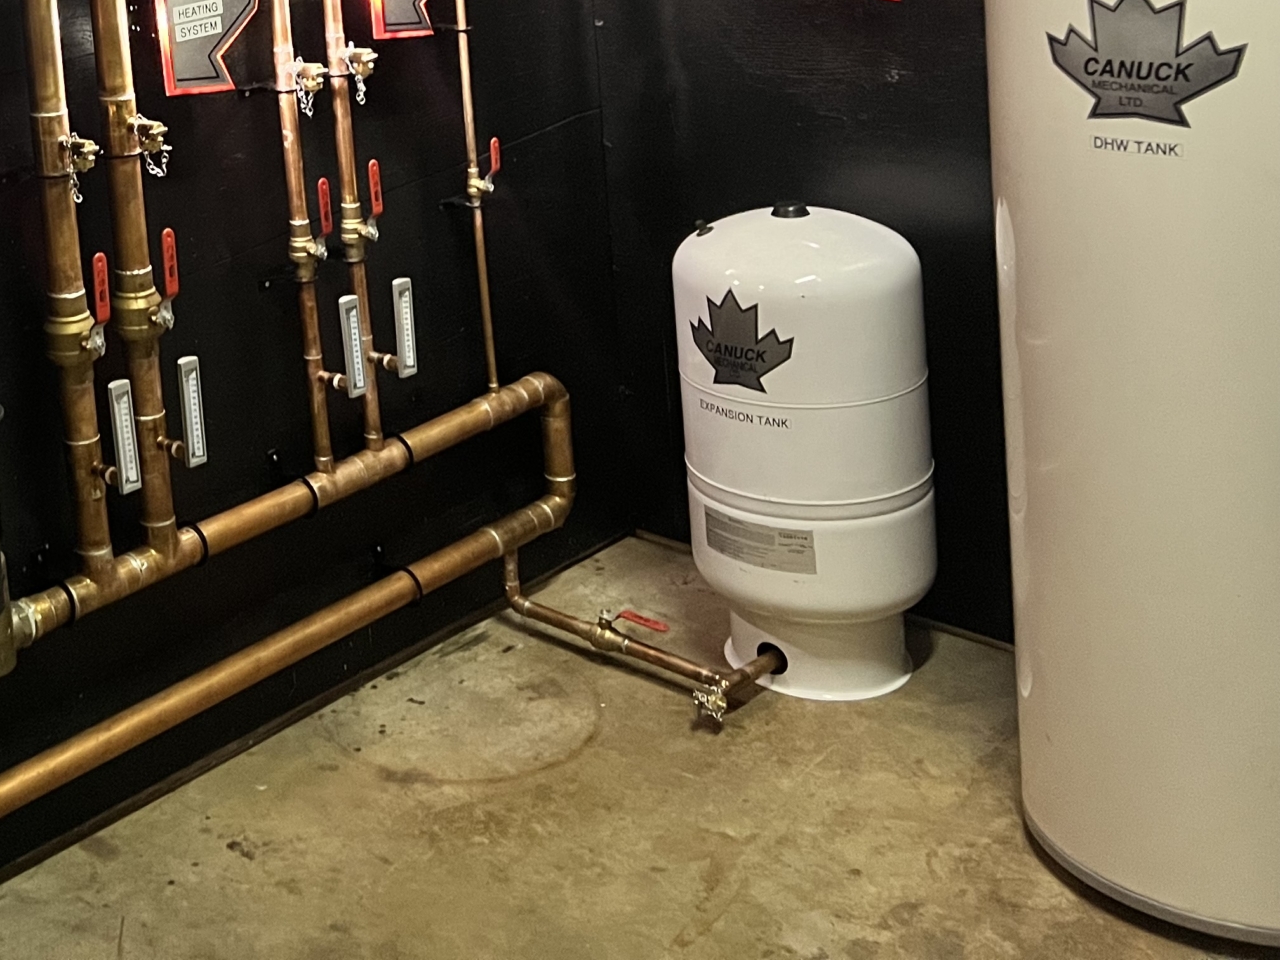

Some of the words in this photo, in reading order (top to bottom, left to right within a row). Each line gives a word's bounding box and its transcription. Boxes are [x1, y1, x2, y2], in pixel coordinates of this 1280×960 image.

[178, 2, 218, 20] HEATING
[180, 20, 217, 38] SYSTEM
[1083, 57, 1194, 83] CANUCK
[1091, 79, 1178, 96] MECHANICAL
[1094, 136, 1129, 152] DHW
[1133, 141, 1179, 157] TANK
[706, 339, 767, 363] CANUCK
[699, 398, 753, 424] EXPANSION
[757, 415, 789, 429] TANK
